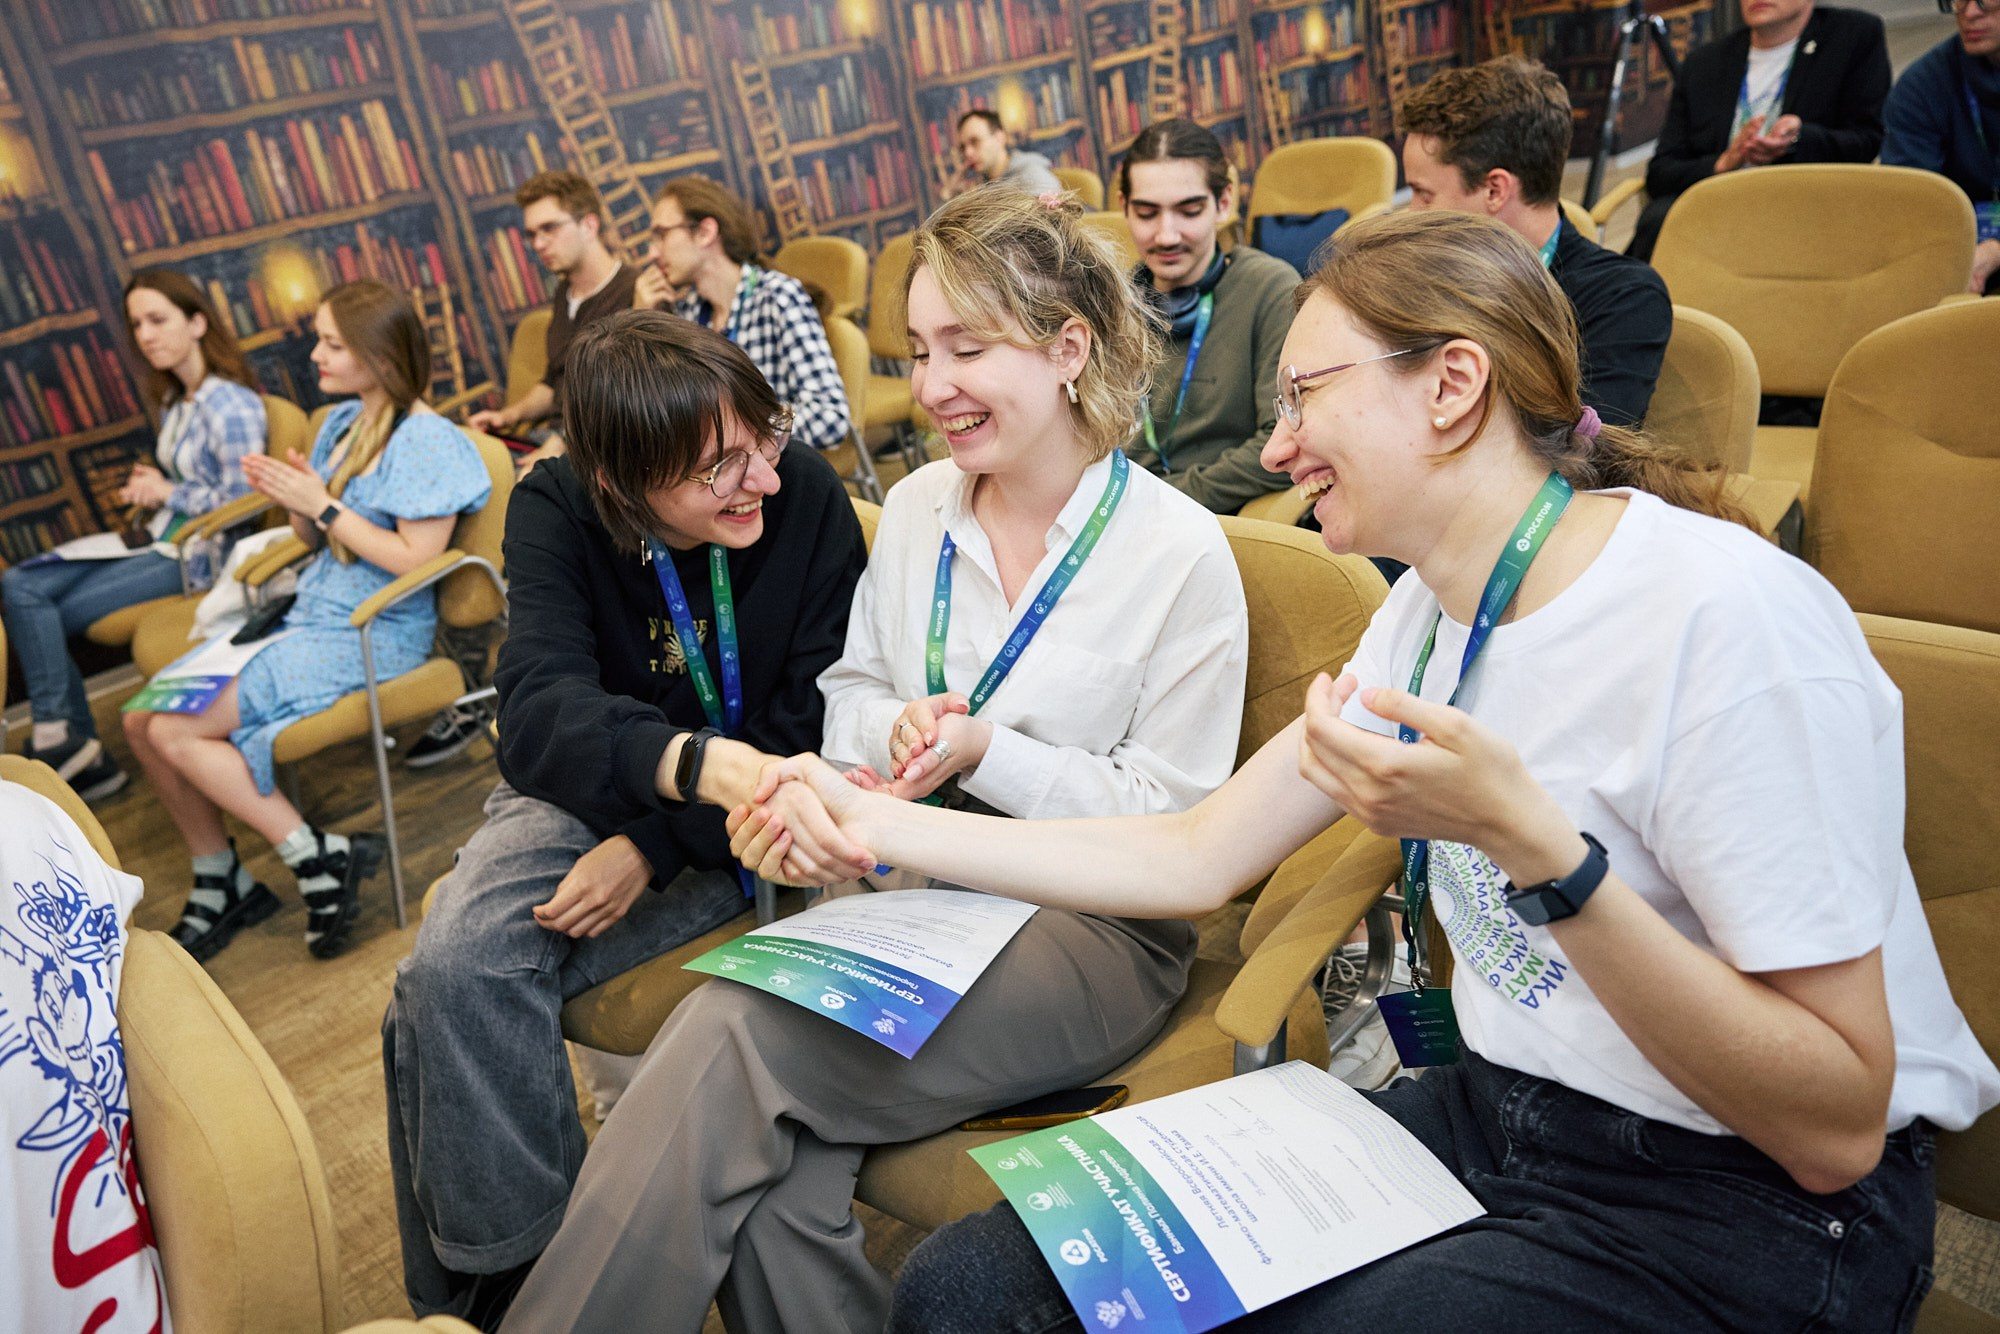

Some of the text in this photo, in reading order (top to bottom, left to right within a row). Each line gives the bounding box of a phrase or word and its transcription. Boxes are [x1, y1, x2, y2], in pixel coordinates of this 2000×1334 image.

[1104, 480, 1120, 510] РОСАТОМ
[1525, 502, 1553, 540] РОСАТОМ
[980, 670, 1000, 695] РОСАТОМ
[739, 943, 832, 965] УЧАСТНИКА
[825, 962, 927, 1005] СЕРТИФИКАТ
[1055, 1134, 1121, 1197] УЧАСТНИКА
[1146, 1139, 1230, 1229] Летняя Всероссийская
[1205, 1165, 1234, 1191] имени
[1097, 1149, 1185, 1254] Банных Полина Андреевна
[1229, 1192, 1259, 1222] школа
[1110, 1197, 1194, 1302] СЕРТИФИКАТ
